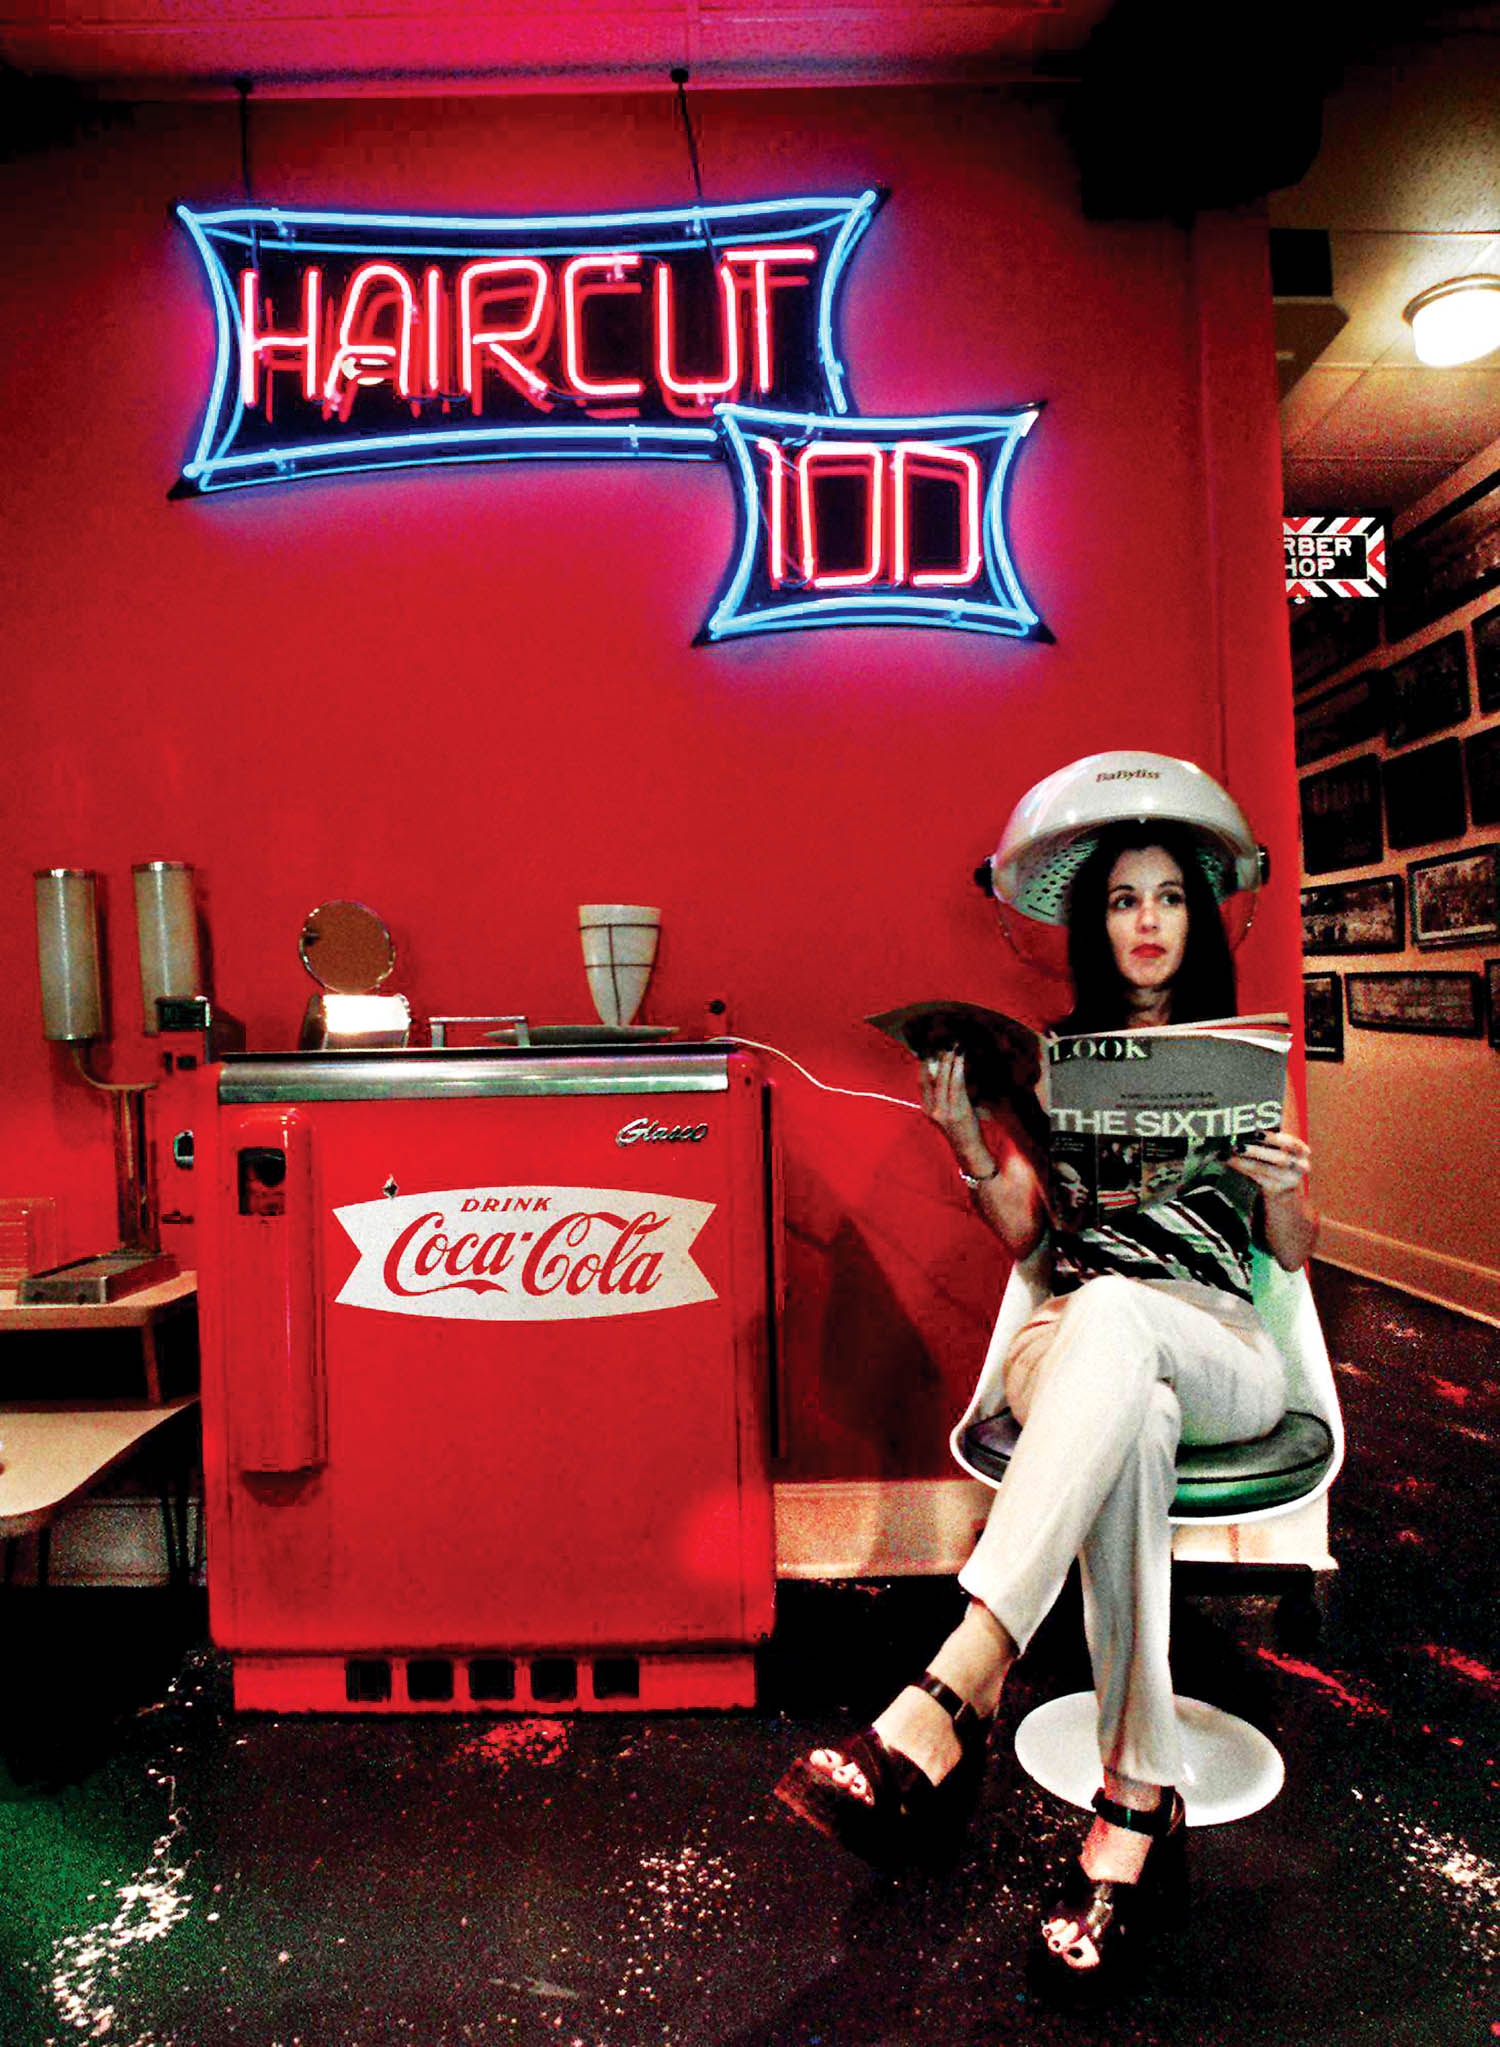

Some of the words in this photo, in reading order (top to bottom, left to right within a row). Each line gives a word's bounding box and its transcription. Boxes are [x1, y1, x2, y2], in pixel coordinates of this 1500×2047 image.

[238, 244, 819, 405] HAIRCUT
[1052, 1038, 1149, 1064] LOOK
[1050, 1107, 1128, 1136] THE
[1133, 1100, 1282, 1138] SIXTIES
[460, 1196, 553, 1213] DRINK
